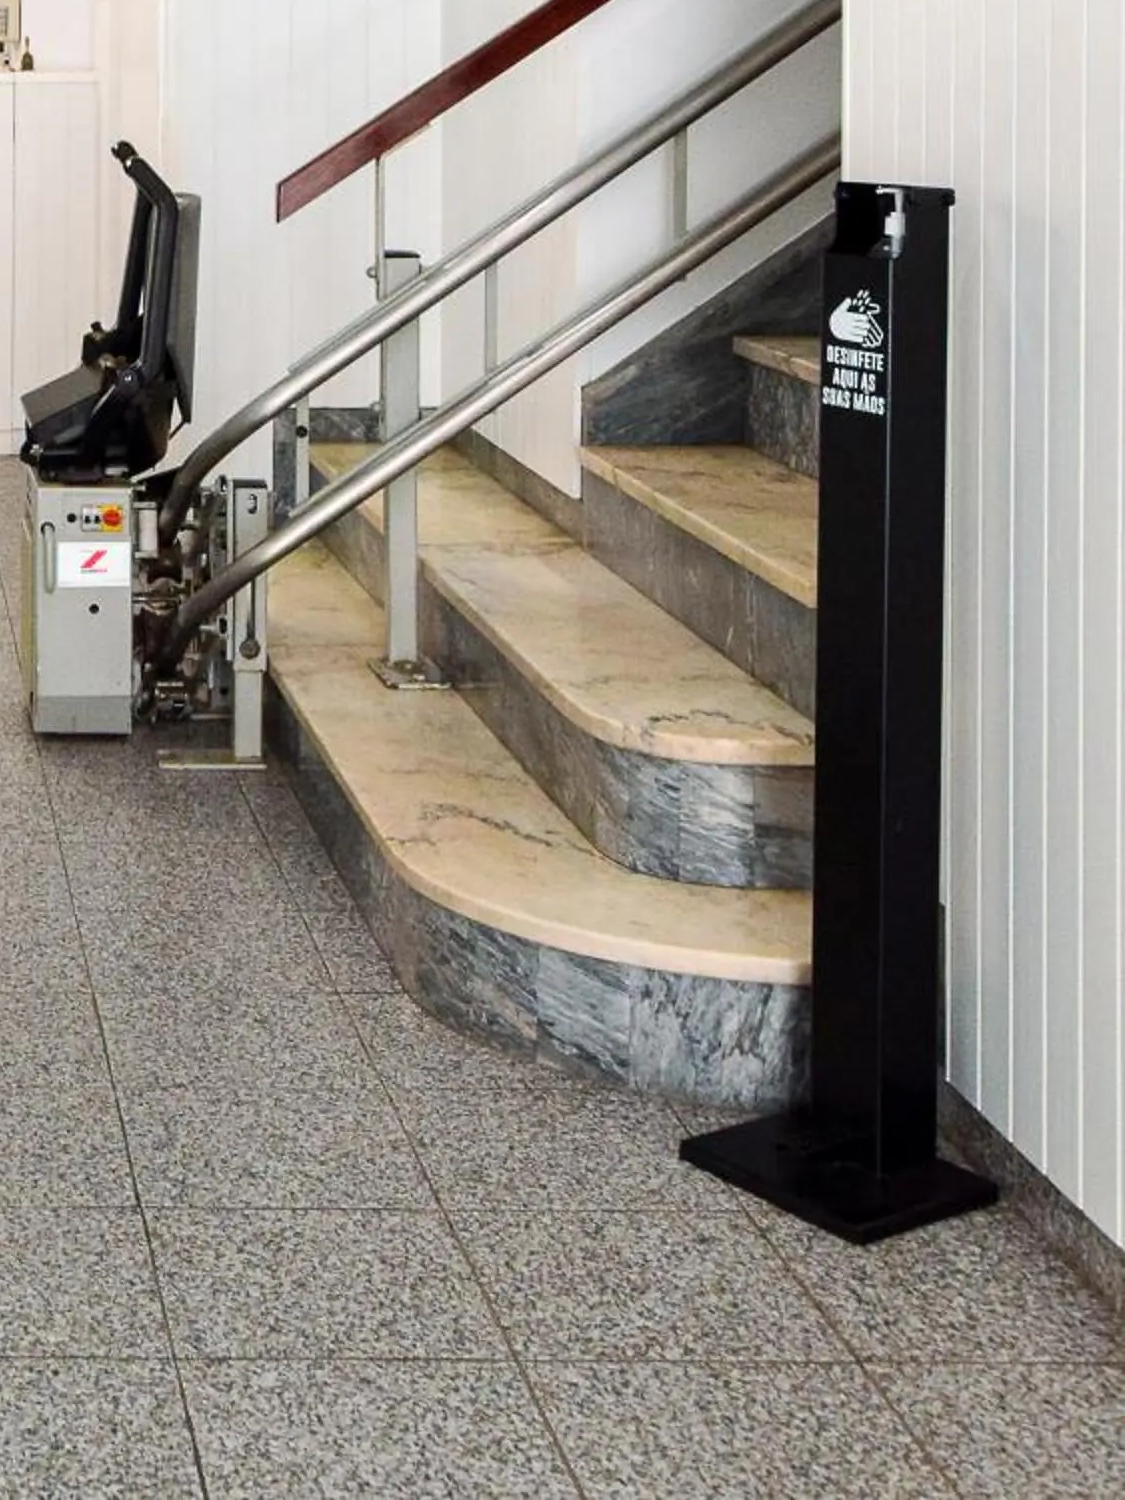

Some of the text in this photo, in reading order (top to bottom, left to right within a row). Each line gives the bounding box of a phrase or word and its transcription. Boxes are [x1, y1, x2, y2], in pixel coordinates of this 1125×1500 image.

[826, 344, 884, 372] DESINFETE
[832, 367, 876, 392] AQUI AS
[822, 386, 851, 409] SUAS
